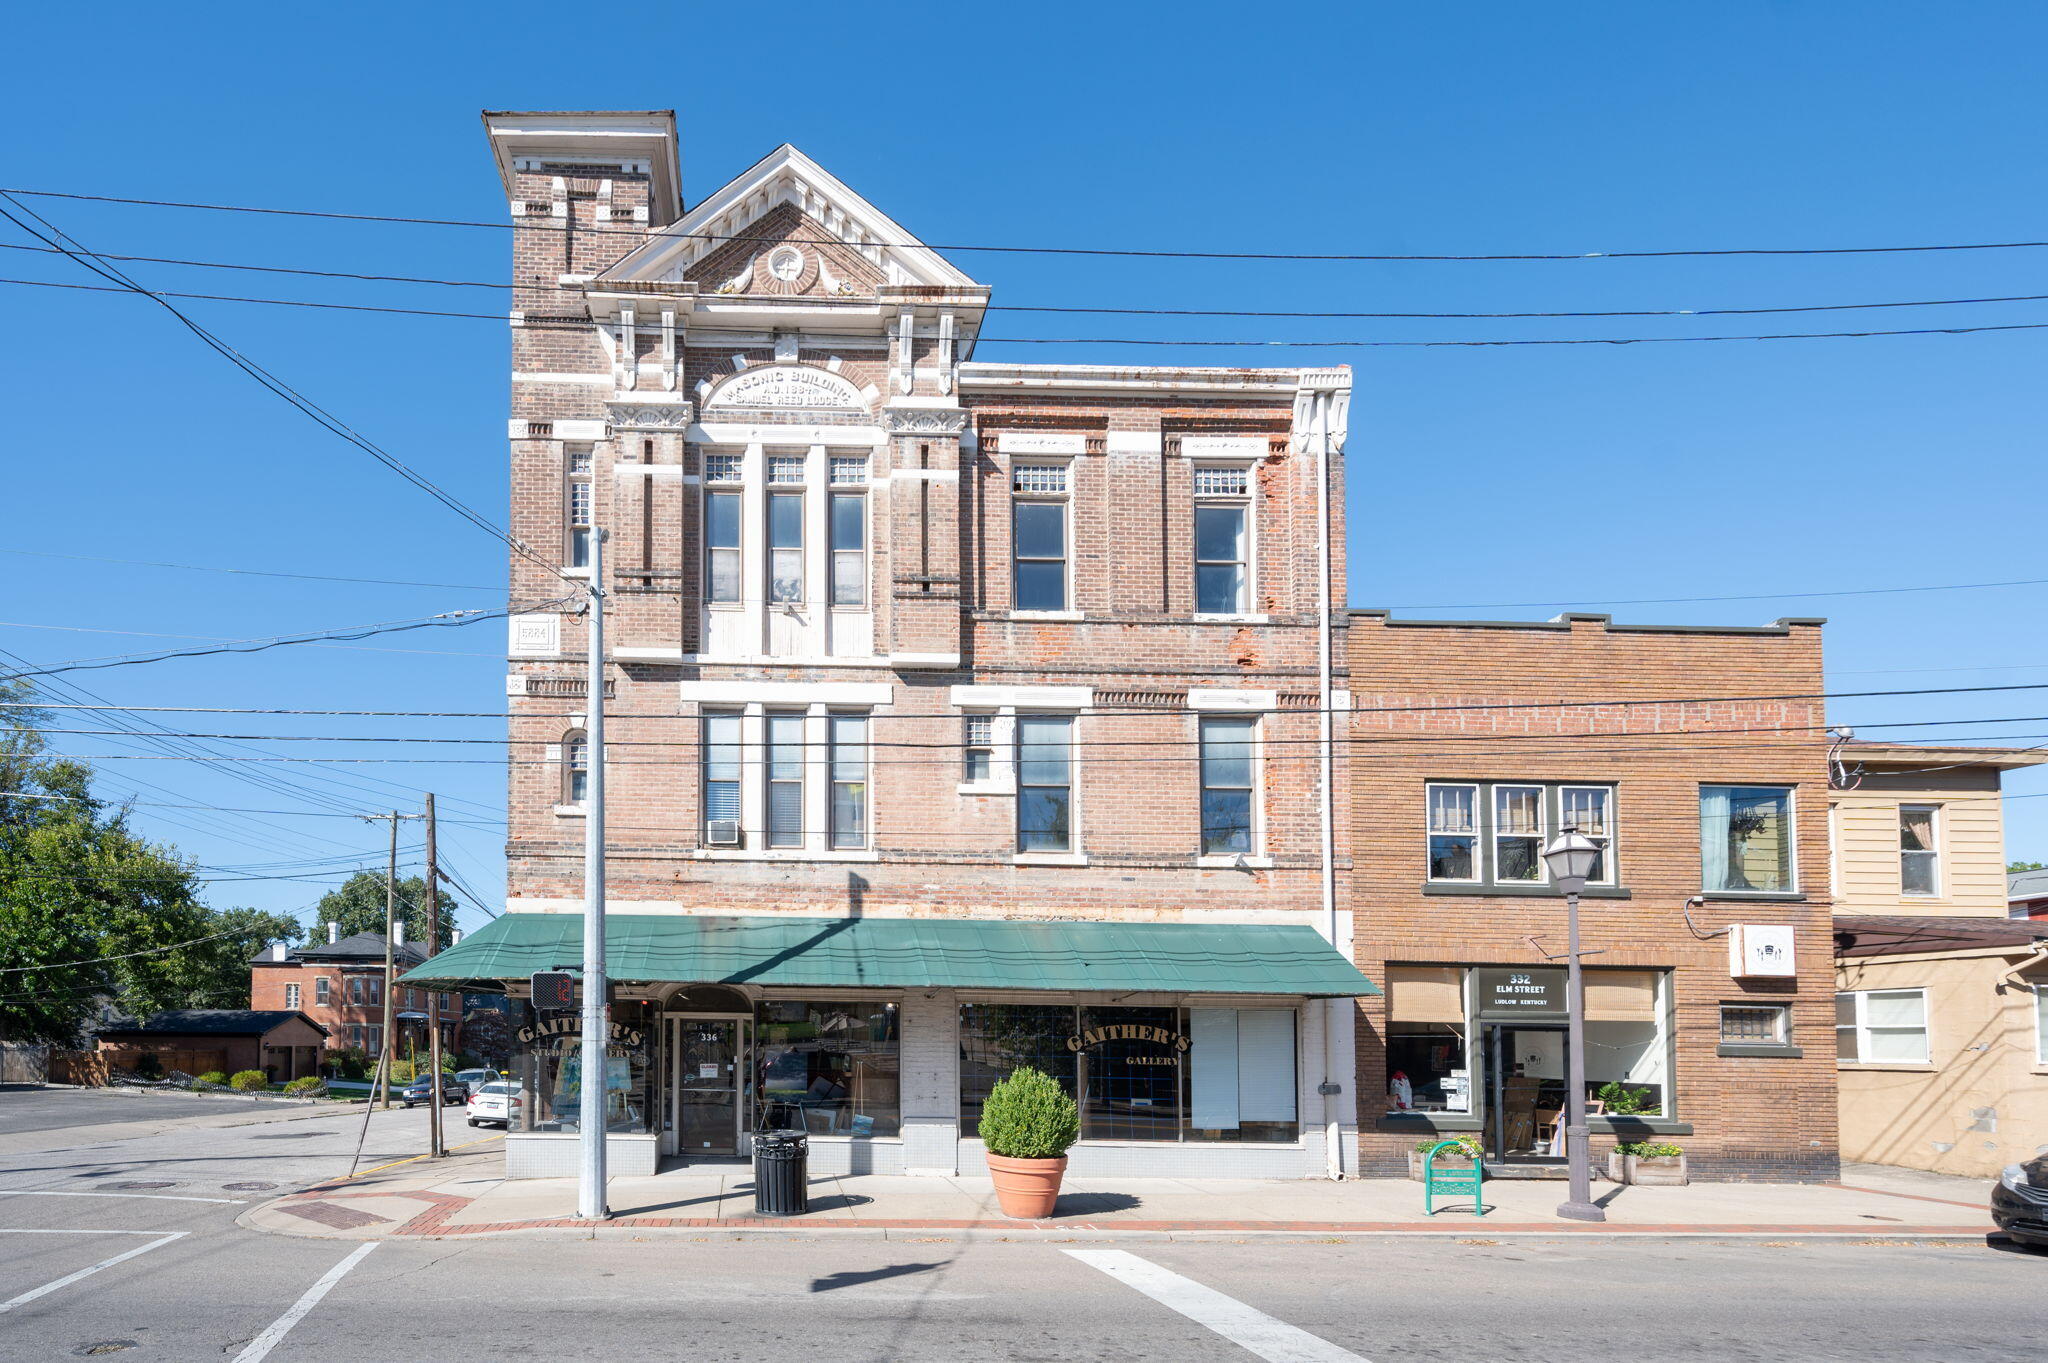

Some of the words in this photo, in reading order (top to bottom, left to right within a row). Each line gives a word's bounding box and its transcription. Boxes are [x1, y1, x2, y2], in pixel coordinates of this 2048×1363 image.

[722, 371, 784, 401] MASONIC
[736, 394, 773, 405] SAMUEL
[776, 395, 803, 406] REED
[1510, 974, 1531, 984] 332
[1496, 985, 1513, 993] ELM
[1514, 986, 1545, 994] STREET
[701, 1033, 717, 1041] 336
[1066, 1024, 1191, 1052] GAITHER'S
[1126, 1056, 1178, 1066] GALLERY
